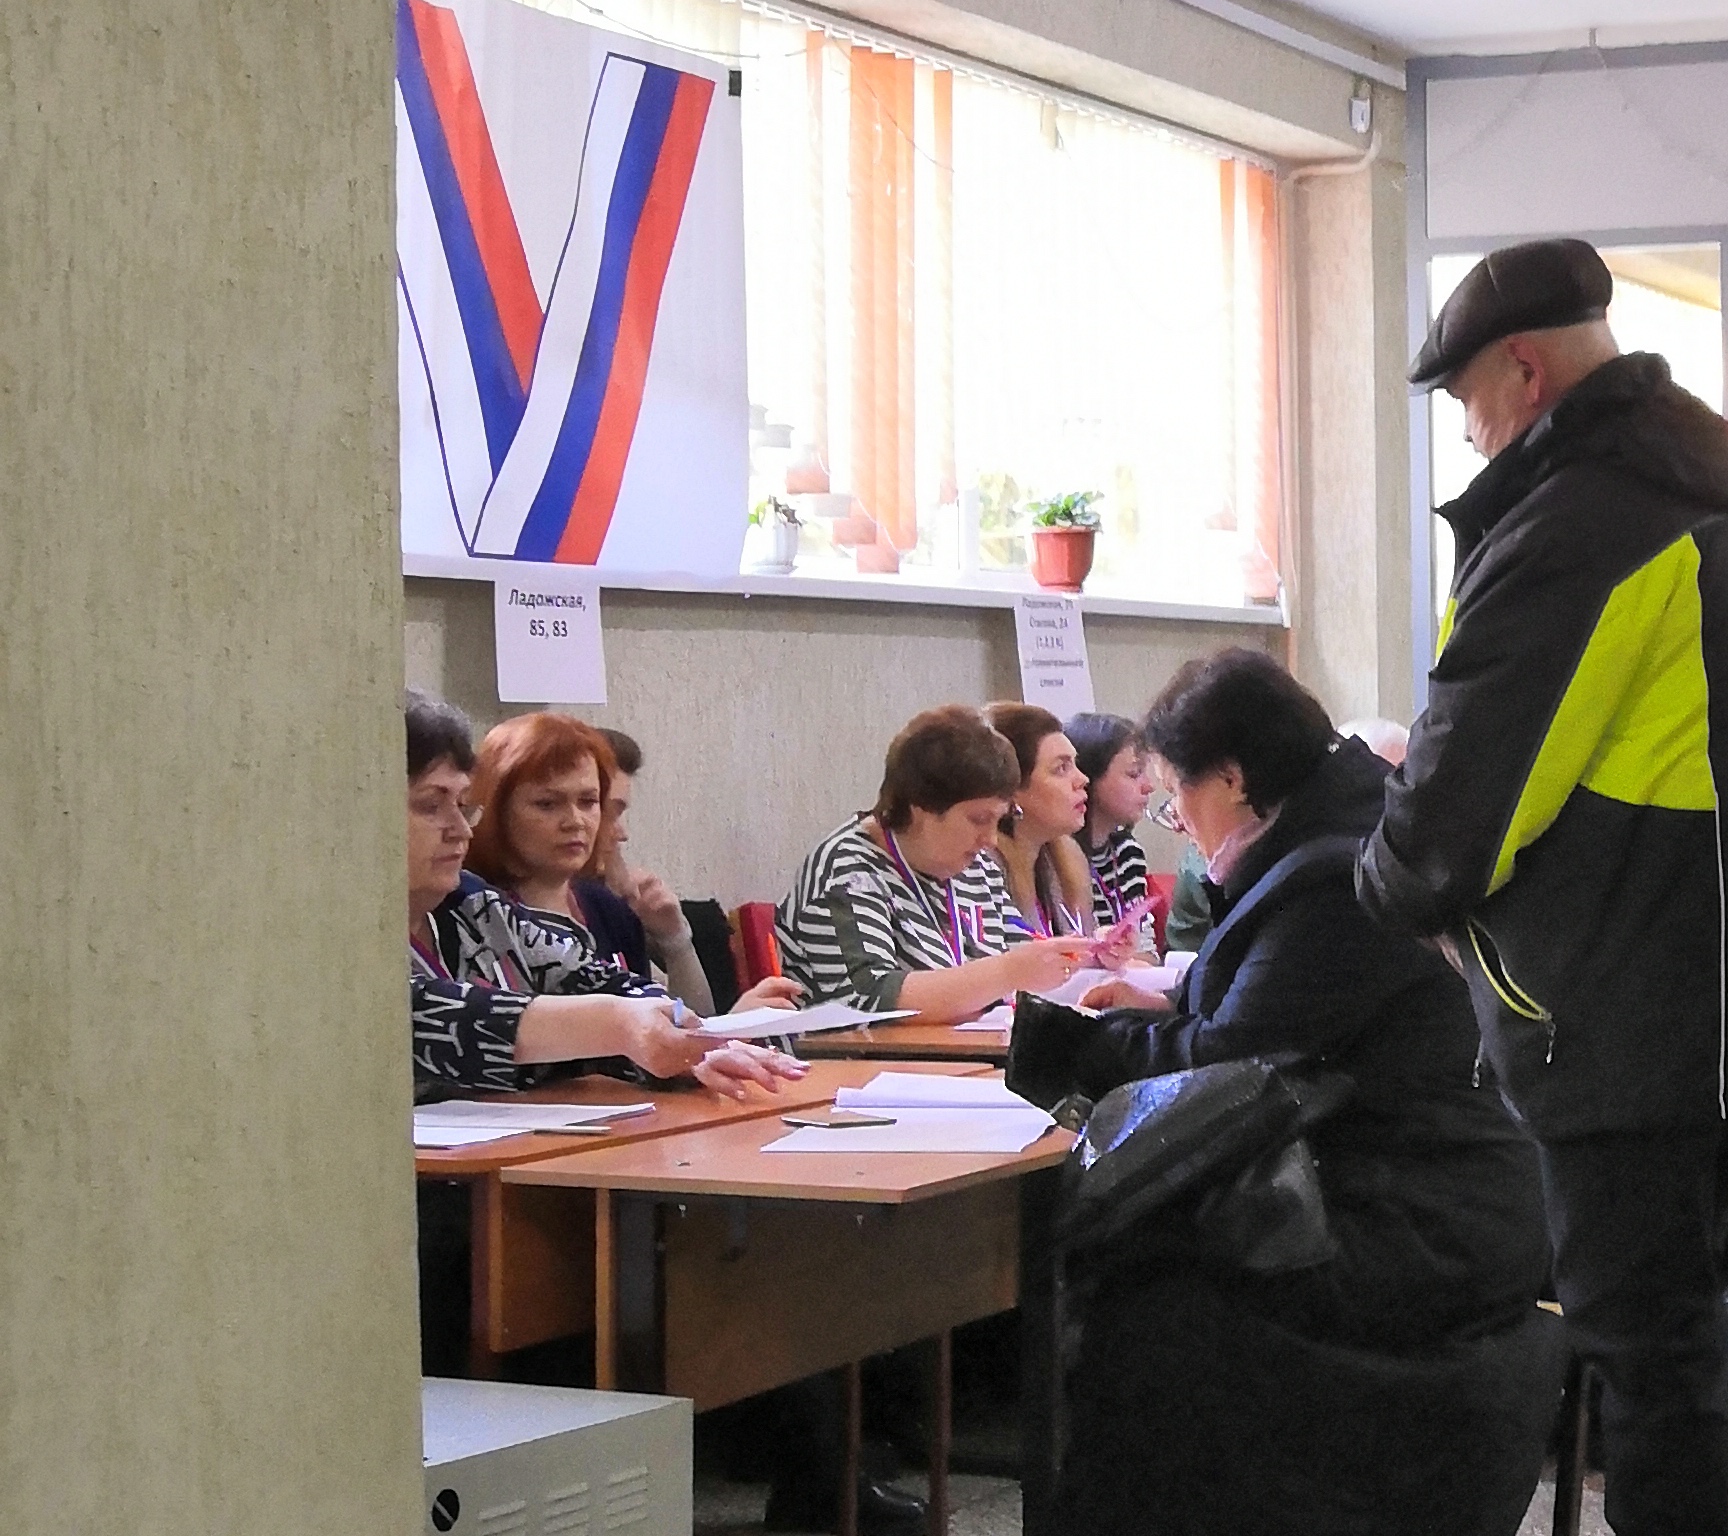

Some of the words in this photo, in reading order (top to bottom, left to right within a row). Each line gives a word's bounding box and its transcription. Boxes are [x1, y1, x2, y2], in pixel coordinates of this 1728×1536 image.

[508, 588, 586, 612] Ладожская,
[529, 619, 549, 639] 85,
[552, 620, 568, 637] 83
